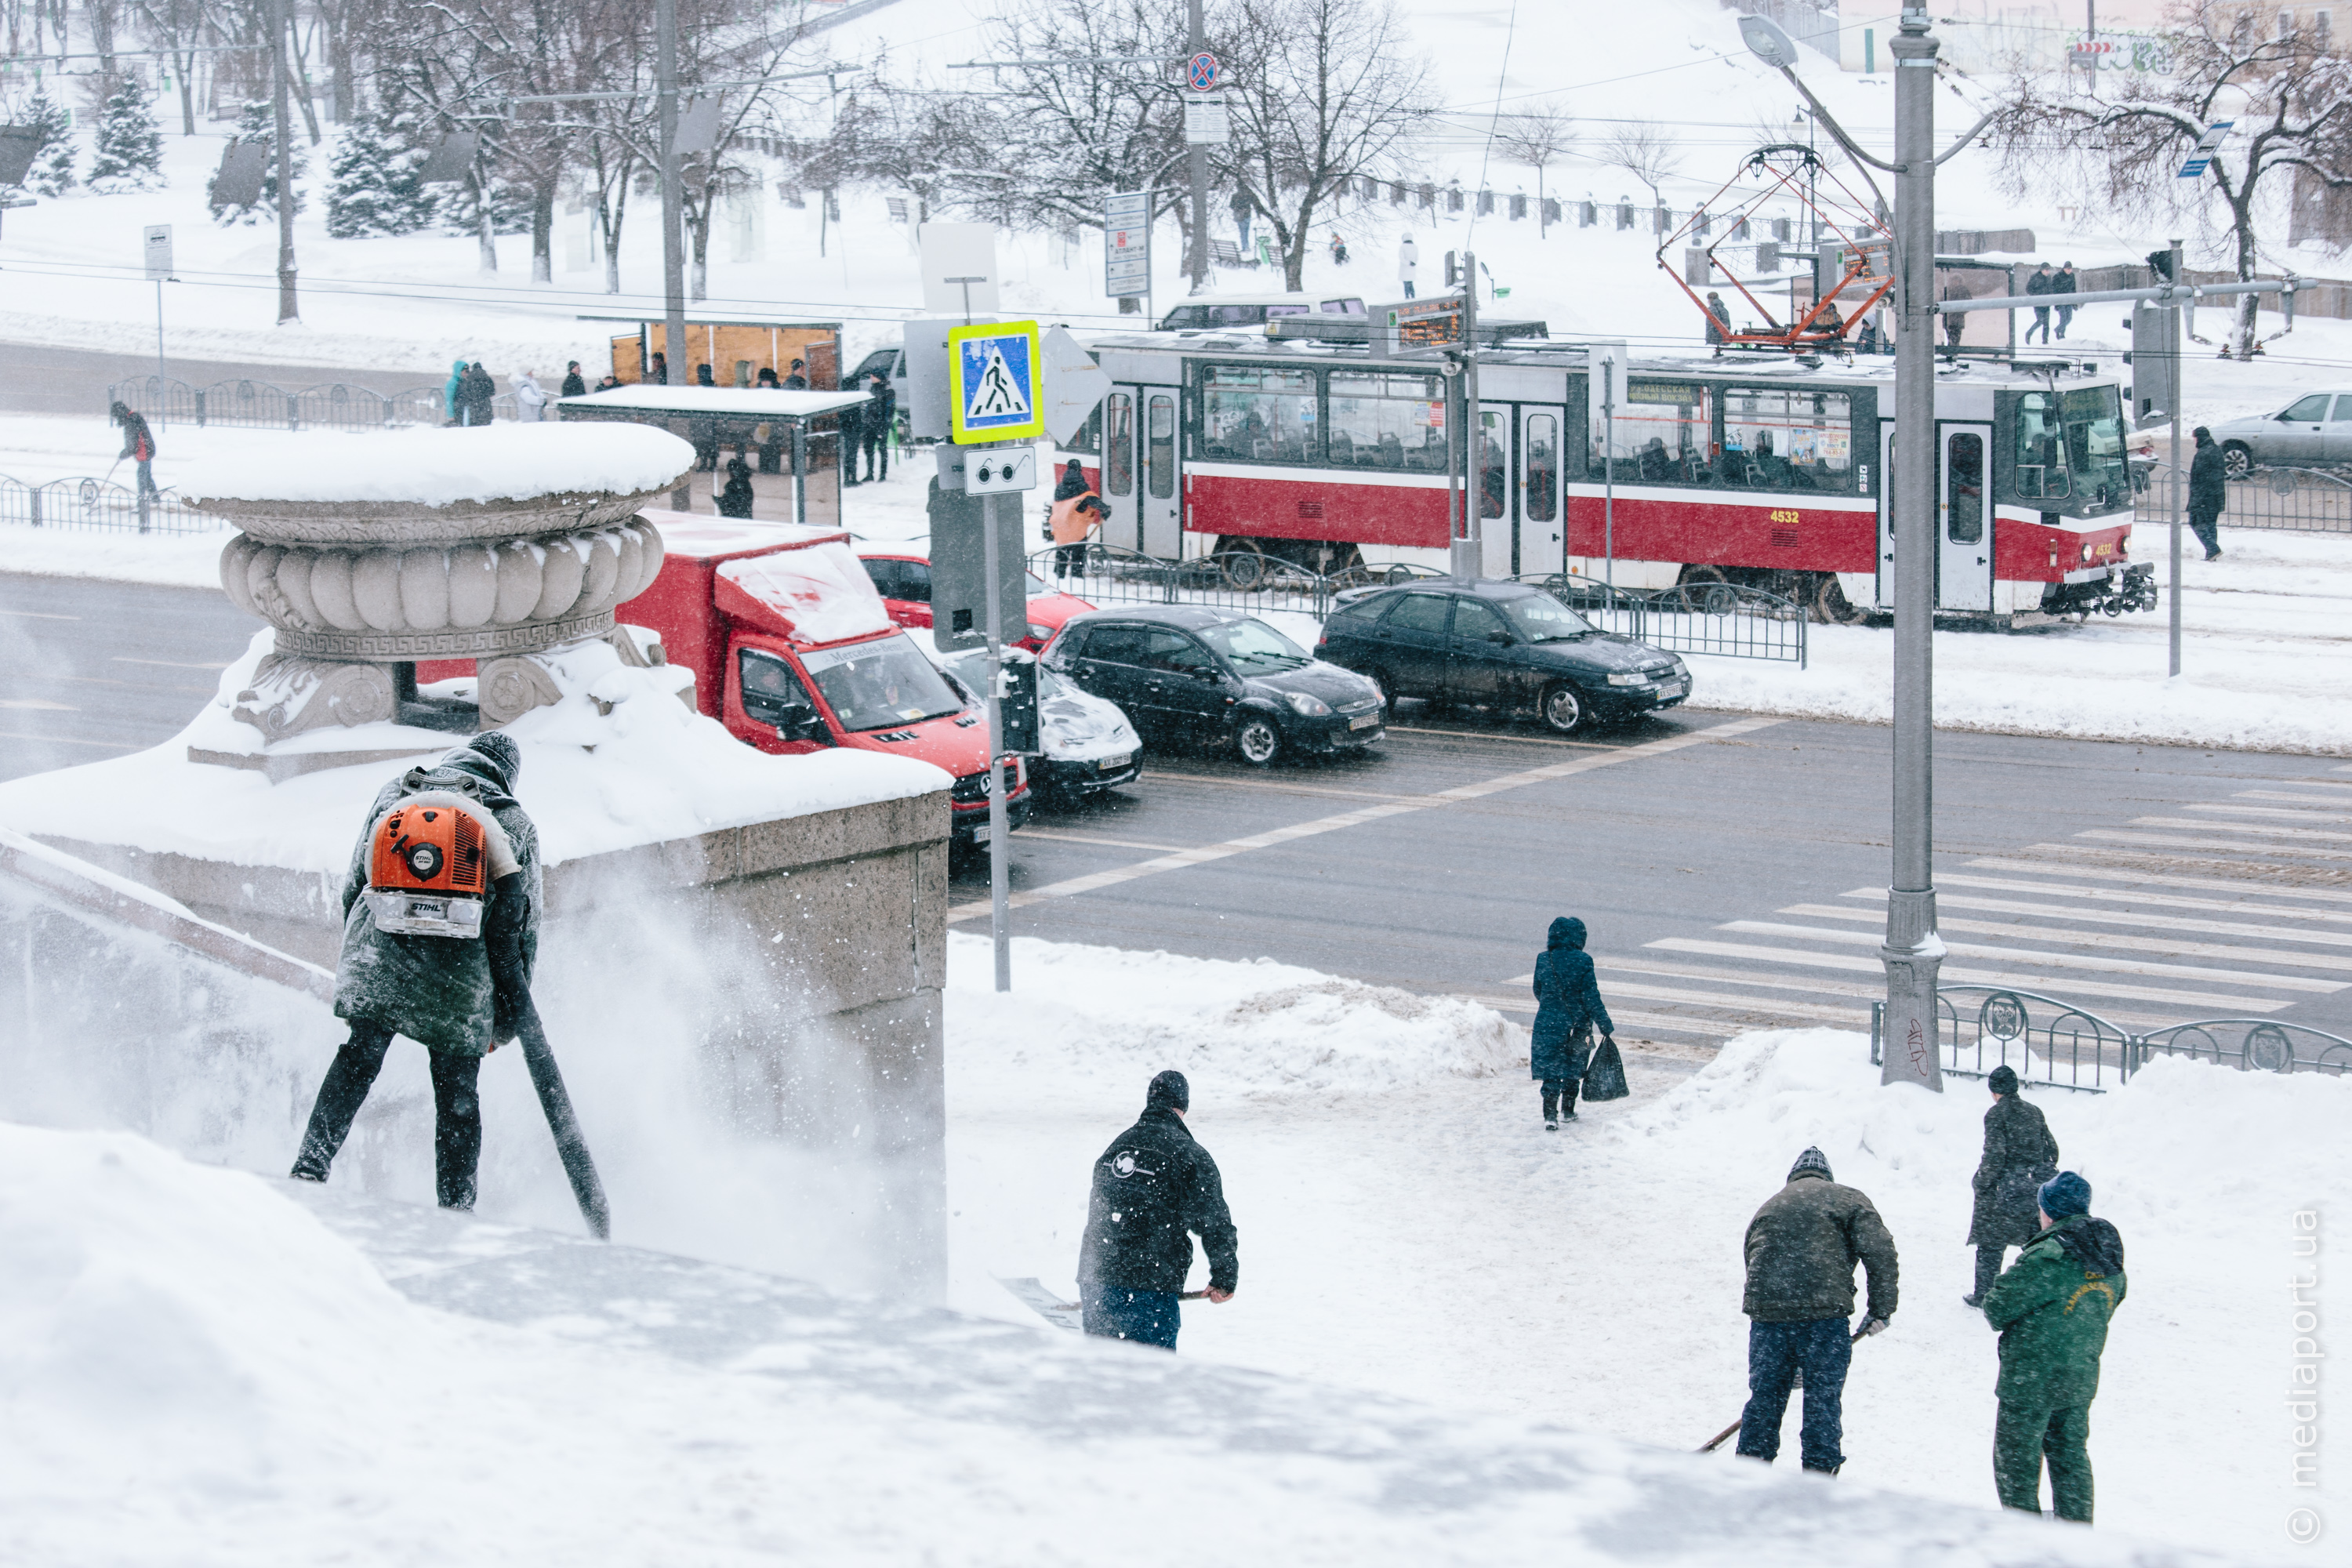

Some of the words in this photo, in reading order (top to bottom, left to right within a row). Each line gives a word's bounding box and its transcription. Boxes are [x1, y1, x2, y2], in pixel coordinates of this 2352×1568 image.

[1770, 510, 1799, 524] 4532
[2096, 543, 2111, 556] 4532
[829, 642, 902, 663] Mercedes-Benz
[1104, 758, 1111, 767] AX
[411, 902, 441, 912] STIHL
